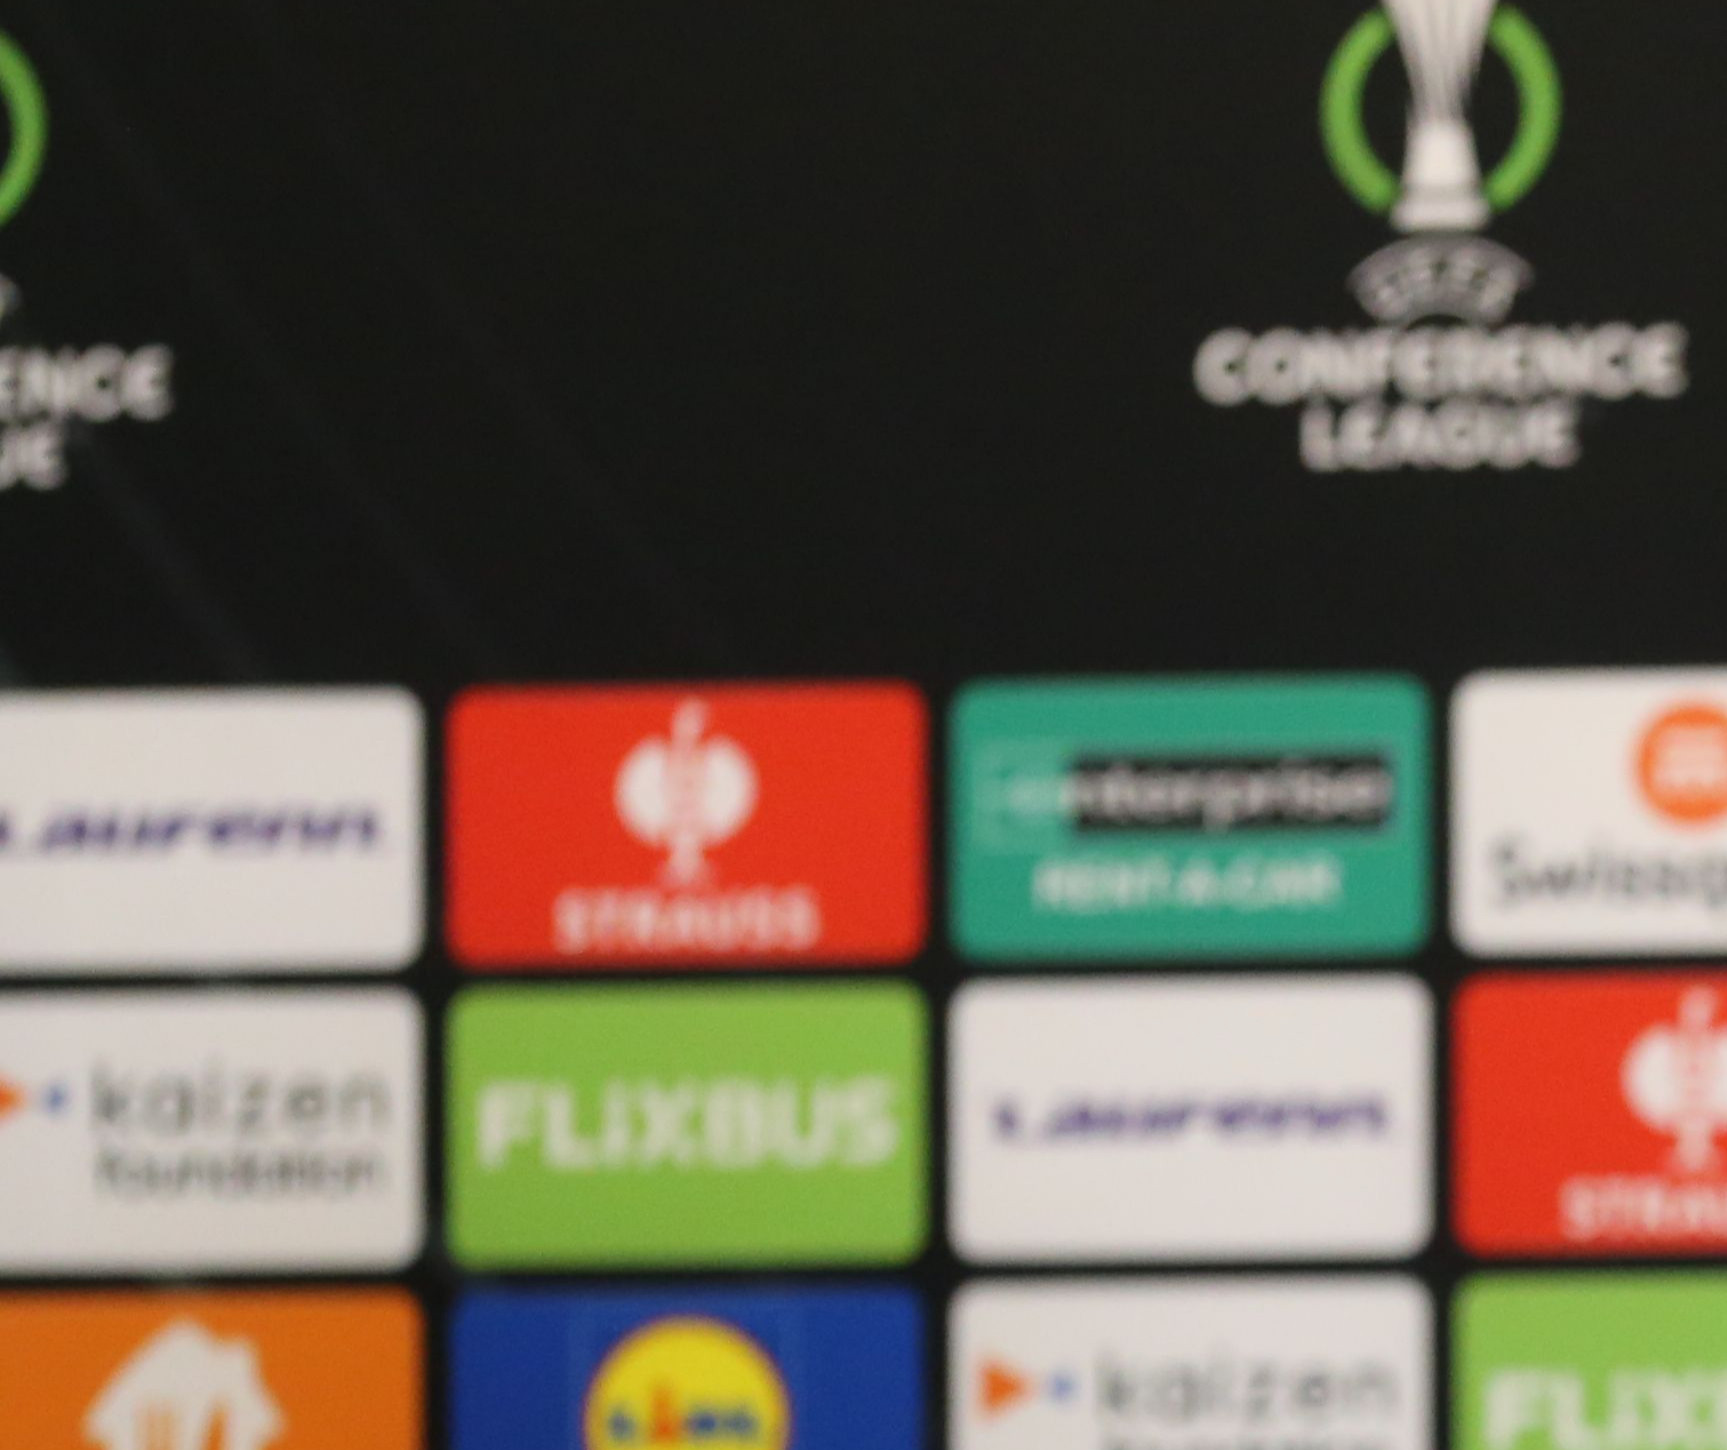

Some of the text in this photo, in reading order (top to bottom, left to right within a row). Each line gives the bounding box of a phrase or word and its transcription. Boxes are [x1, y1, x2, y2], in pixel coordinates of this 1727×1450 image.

[1194, 322, 1687, 405] CONFERENCE
[1301, 402, 1579, 471] LEAGUE
[553, 889, 822, 952] STRAUSS
[90, 1062, 390, 1126] kaizen
[1096, 1356, 1397, 1422] kaizen
